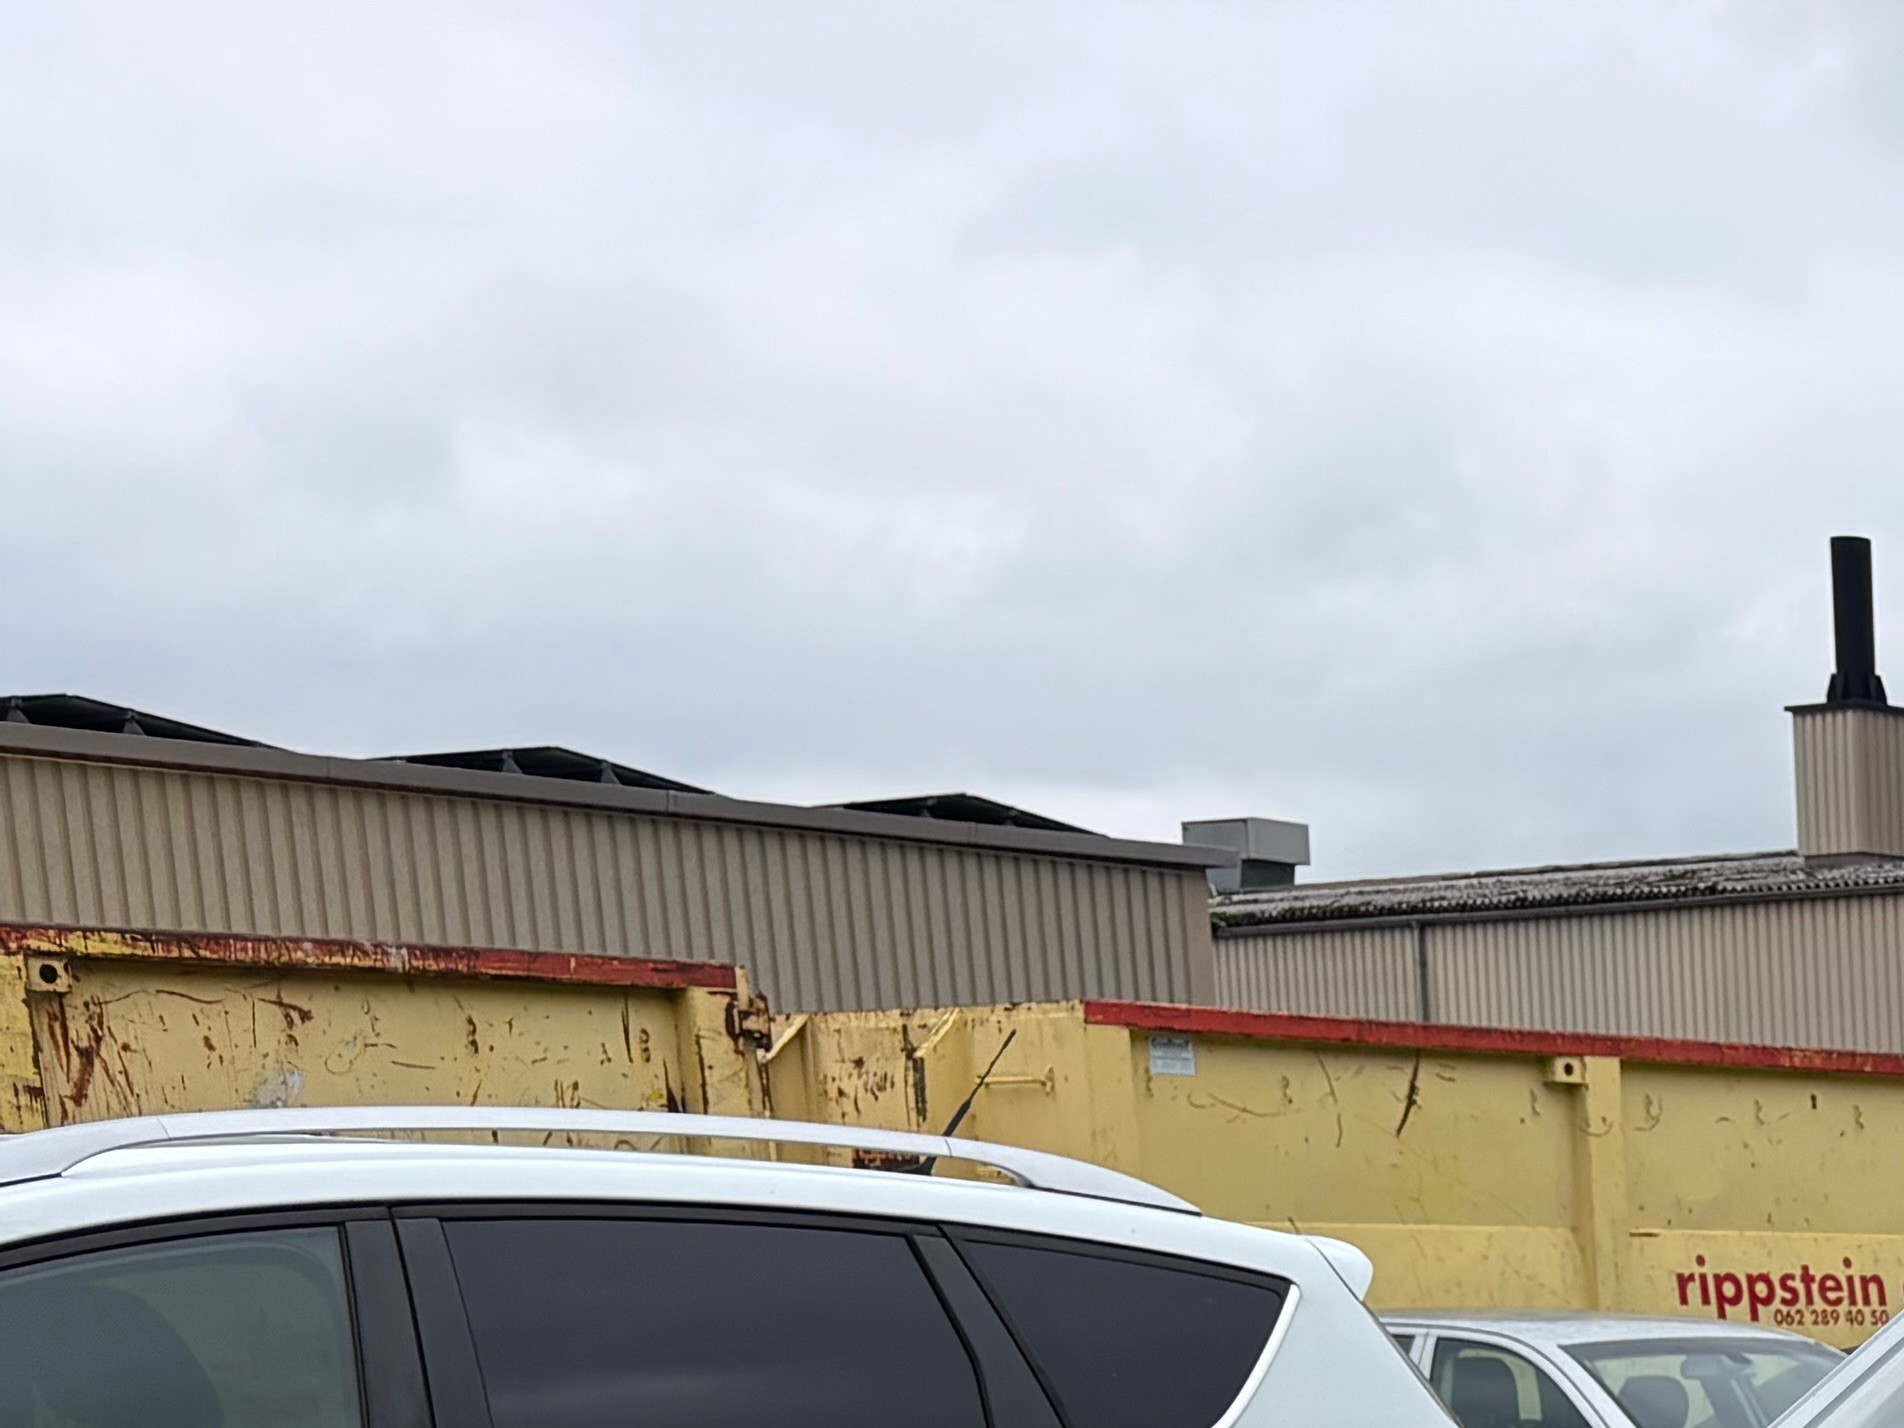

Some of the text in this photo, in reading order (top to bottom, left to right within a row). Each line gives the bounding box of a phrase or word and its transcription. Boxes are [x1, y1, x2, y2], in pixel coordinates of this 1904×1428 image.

[1676, 1254, 1887, 1322] rippstein
[1773, 1309, 1805, 1326] 062
[1810, 1309, 1840, 1326] 289
[1870, 1309, 1890, 1327] 50
